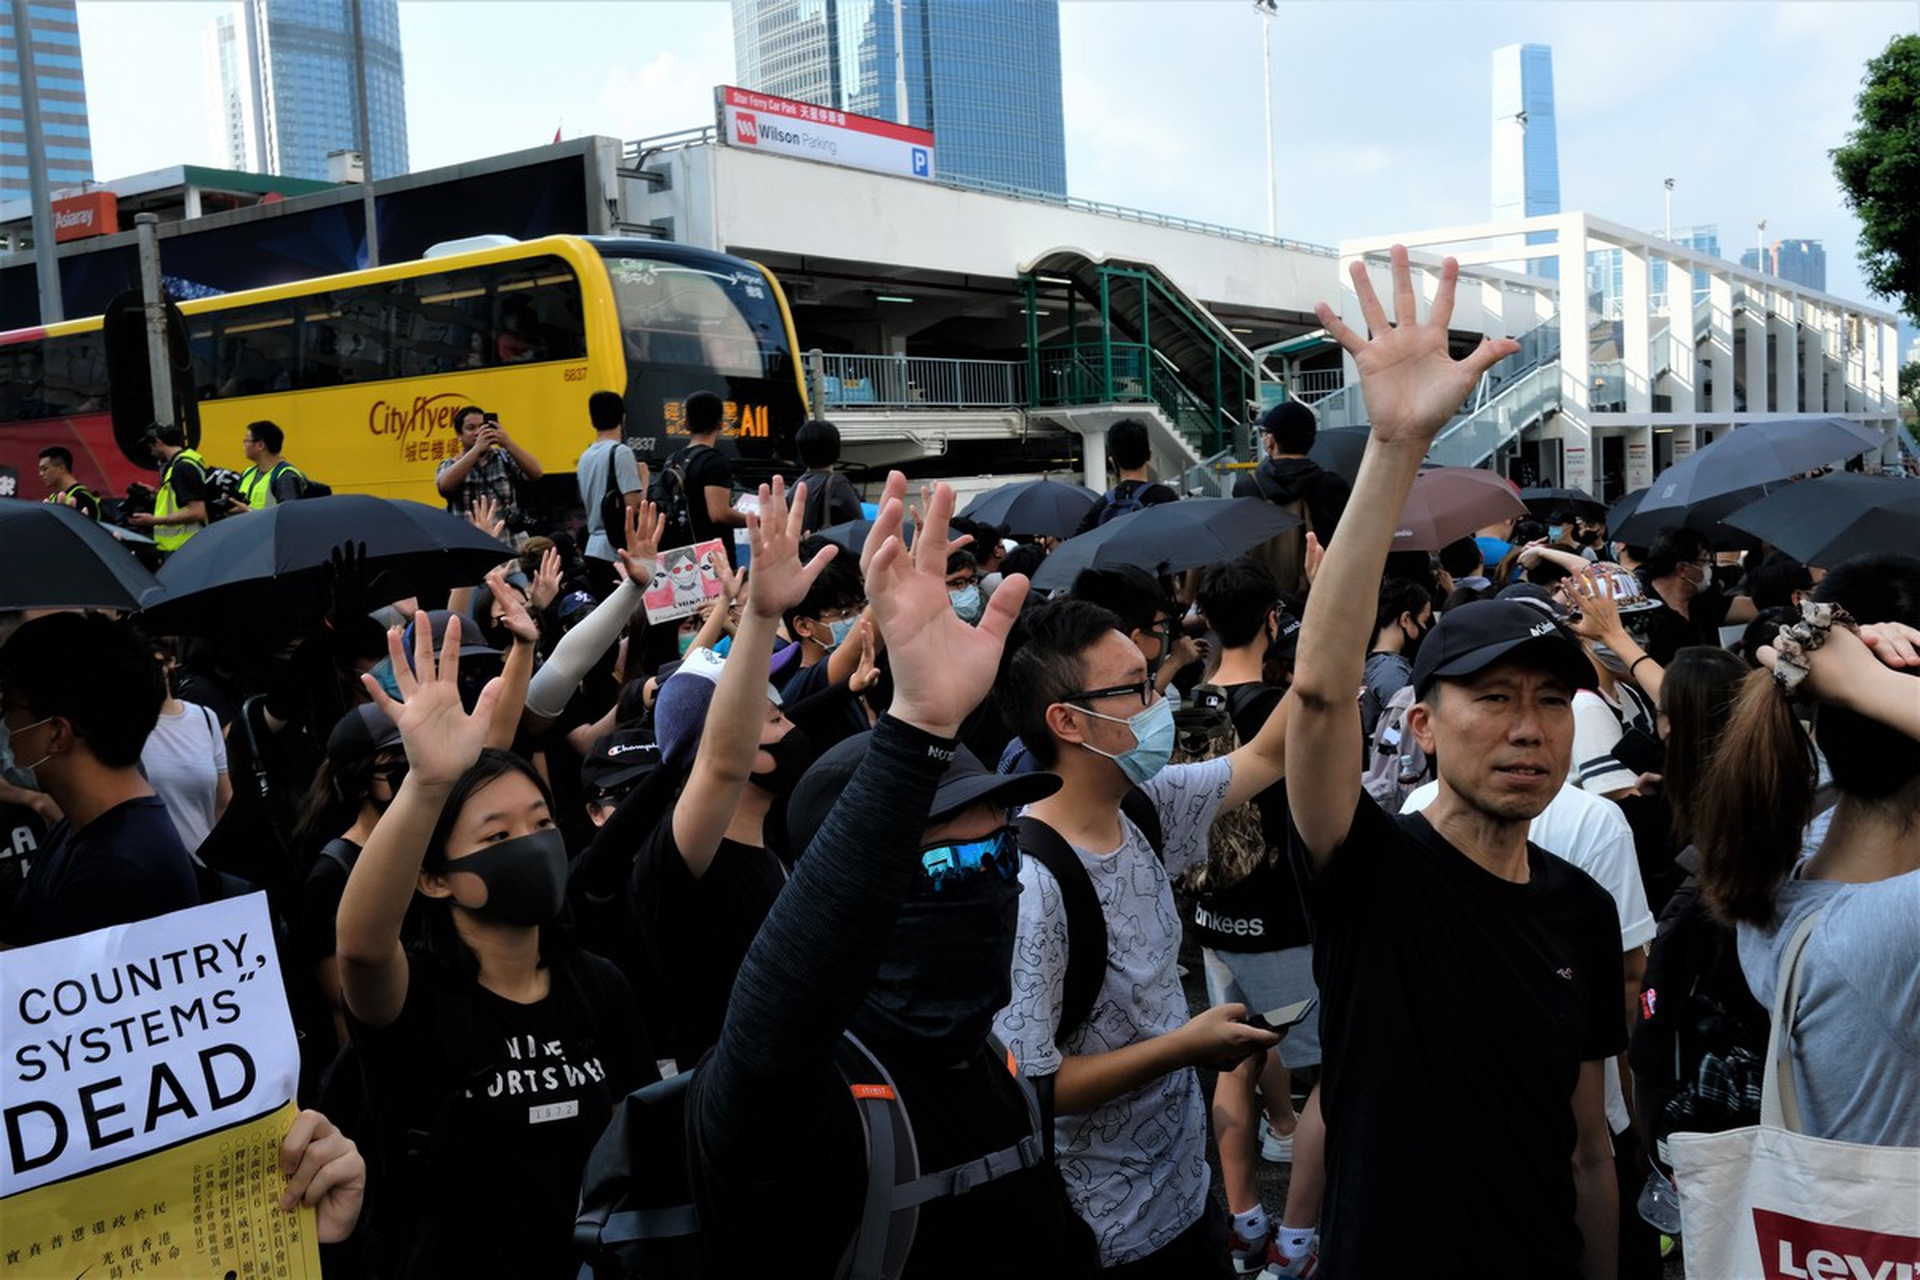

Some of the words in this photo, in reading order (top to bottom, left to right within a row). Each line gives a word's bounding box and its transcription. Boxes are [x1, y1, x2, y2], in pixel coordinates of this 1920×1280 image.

[733, 91, 749, 105] Star
[750, 95, 767, 111] Ferry
[769, 99, 780, 111] Car
[781, 101, 797, 115] Park
[758, 123, 800, 146] Wilson
[802, 132, 838, 157] Parking
[55, 208, 94, 230] Asiaray
[563, 367, 588, 382] 6837
[627, 436, 656, 450] 6837
[608, 742, 659, 757] Champi
[1194, 901, 1265, 937] ankees
[18, 932, 267, 1025] COUNTRY,
[3, 1042, 257, 1175] DEAD
[535, 1105, 574, 1120] 1972
[102, 1230, 171, 1267] 光復香港
[109, 1244, 181, 1280] 時代革命
